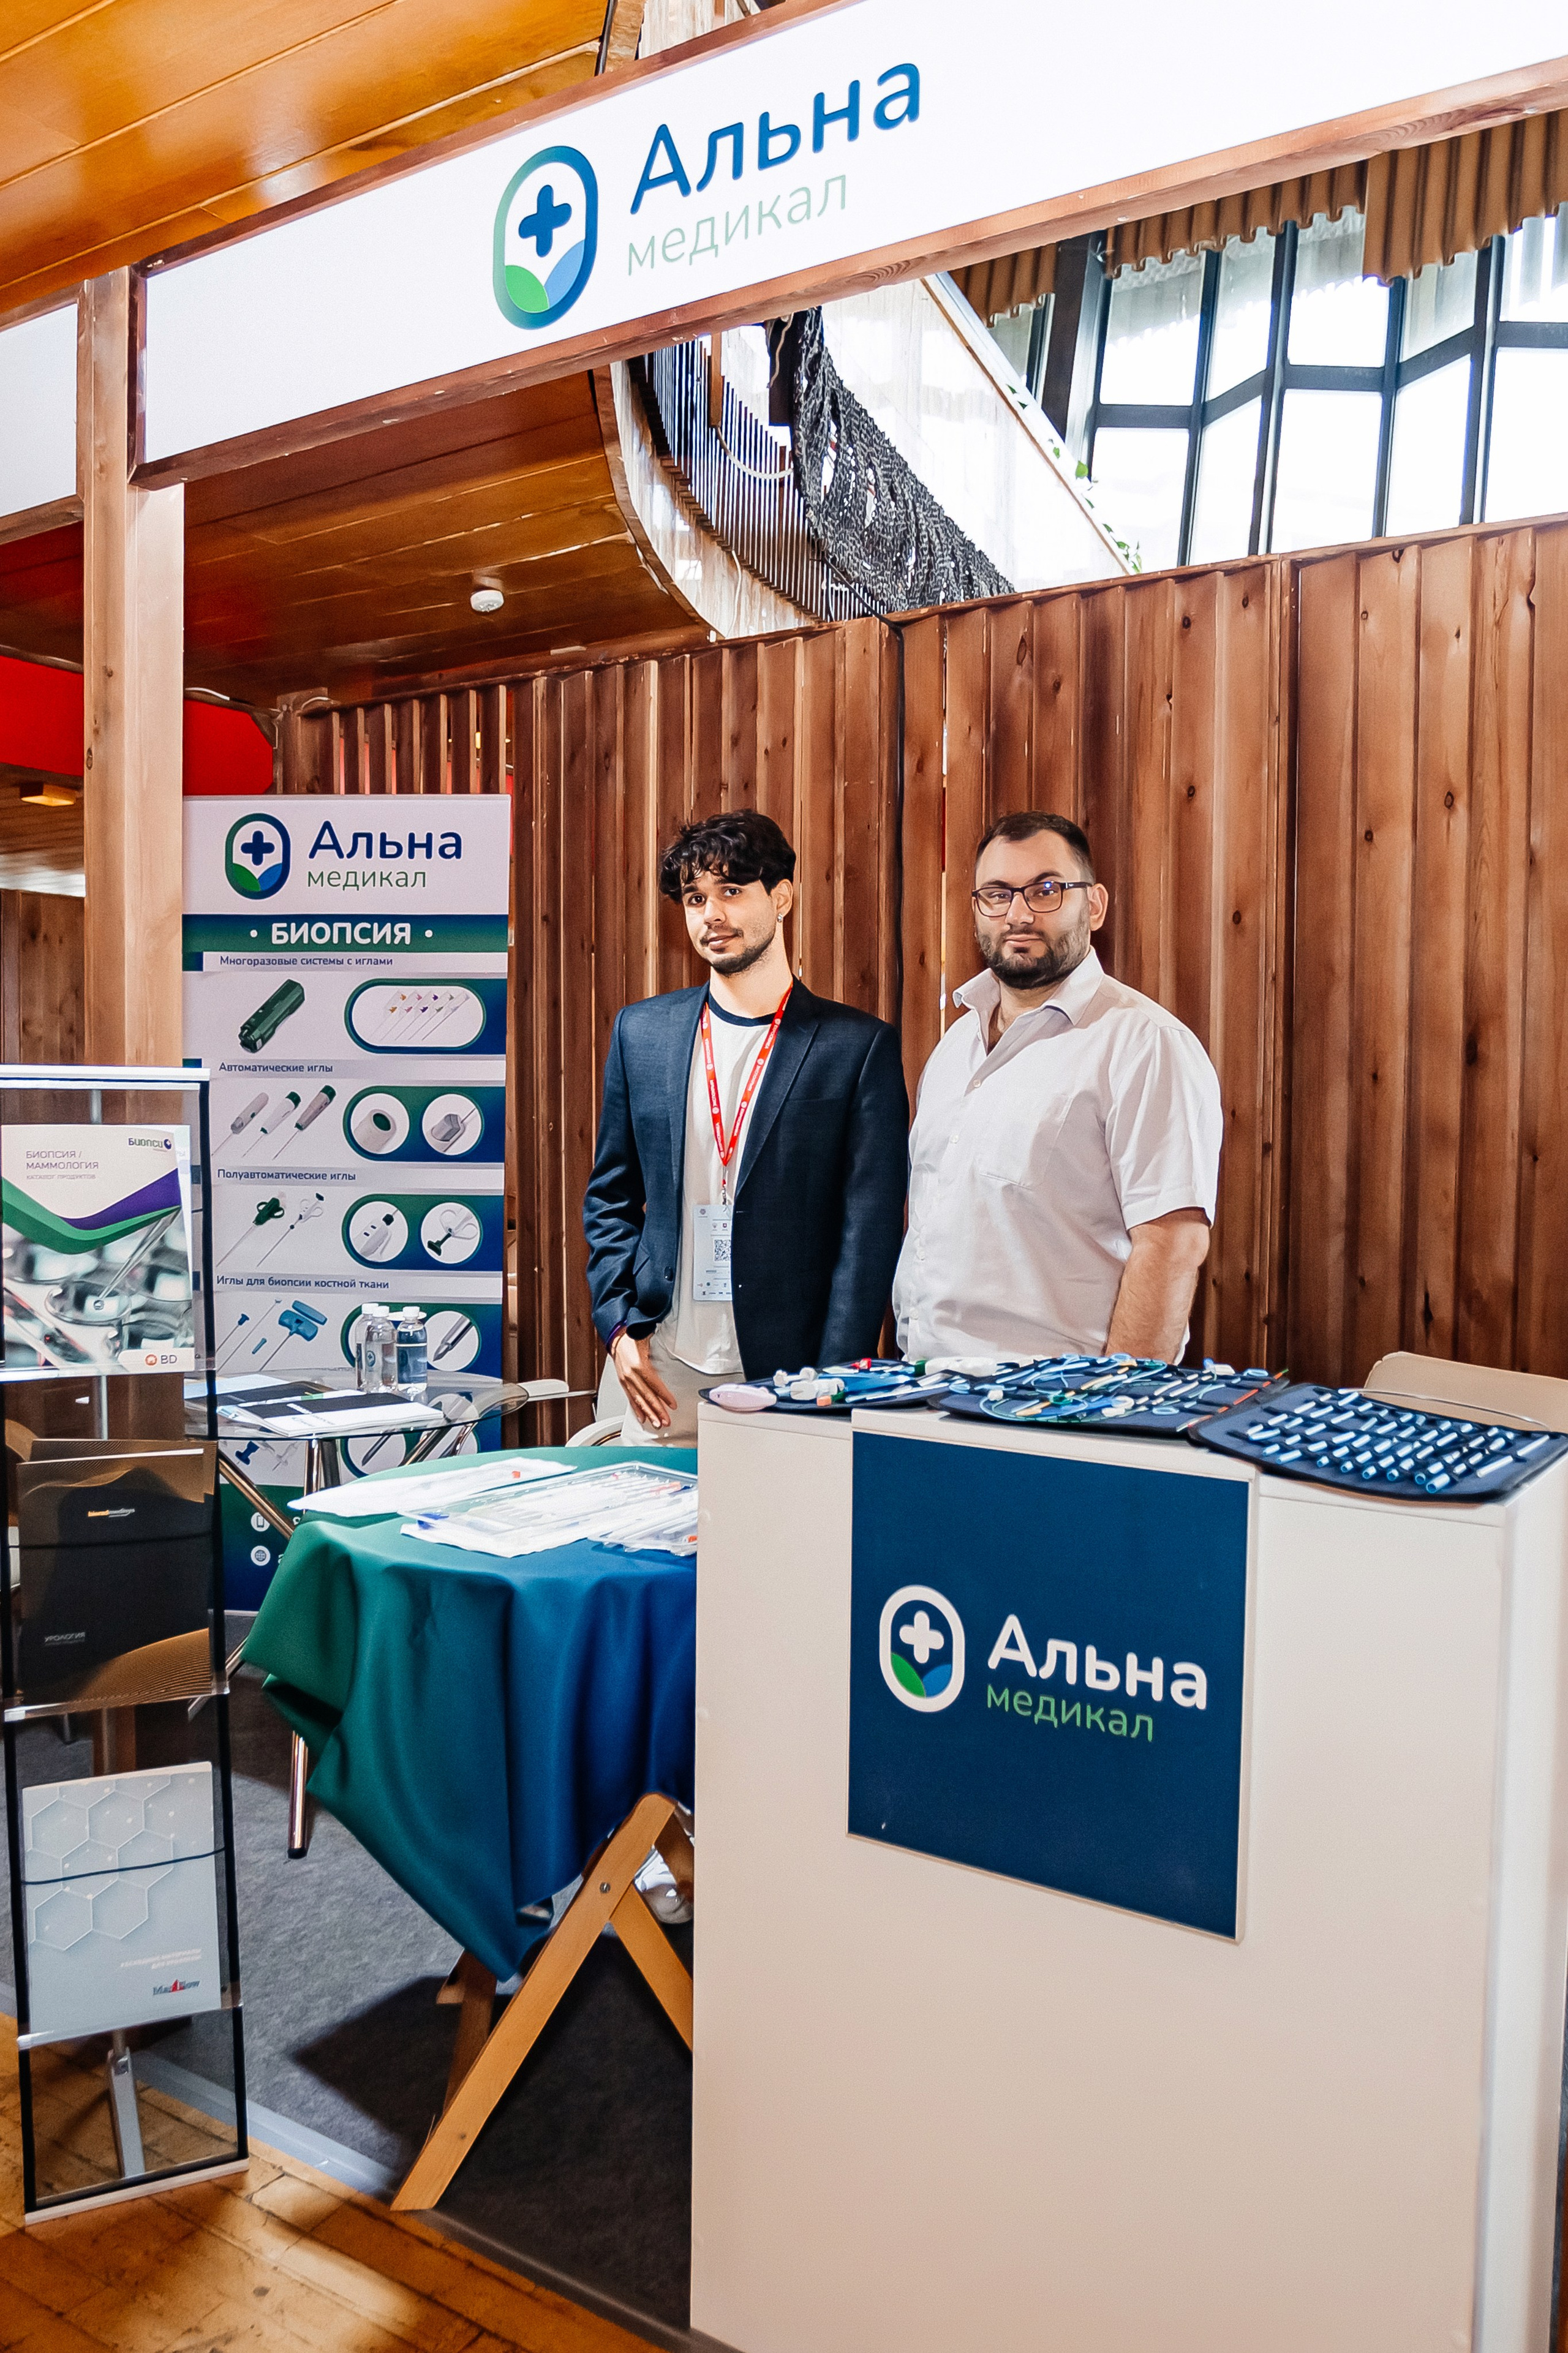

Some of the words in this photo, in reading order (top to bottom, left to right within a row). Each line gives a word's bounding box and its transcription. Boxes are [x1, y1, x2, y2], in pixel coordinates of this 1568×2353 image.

[630, 62, 921, 215] Альна
[628, 174, 847, 276] медикал
[308, 820, 463, 860] Альна
[307, 869, 427, 891] медикал
[271, 922, 412, 946] БИОПСИЯ
[220, 955, 298, 967] Многоразовые
[300, 957, 344, 966] системы
[218, 1061, 305, 1072] Автоматические
[26, 1150, 76, 1159] БИОПСИЯ
[26, 1161, 99, 1170] МАММОЛОГИЯ
[217, 1168, 328, 1181] Полуавтоматические
[330, 1172, 356, 1181] иглы
[216, 1274, 244, 1286] Иглы
[246, 1276, 265, 1287] для
[268, 1276, 312, 1287] биопсии
[314, 1278, 356, 1288] костной
[359, 1281, 390, 1289] ткани
[160, 1354, 178, 1365] BD
[987, 1614, 1207, 1710] Альна
[986, 1684, 1153, 1742] медикал
